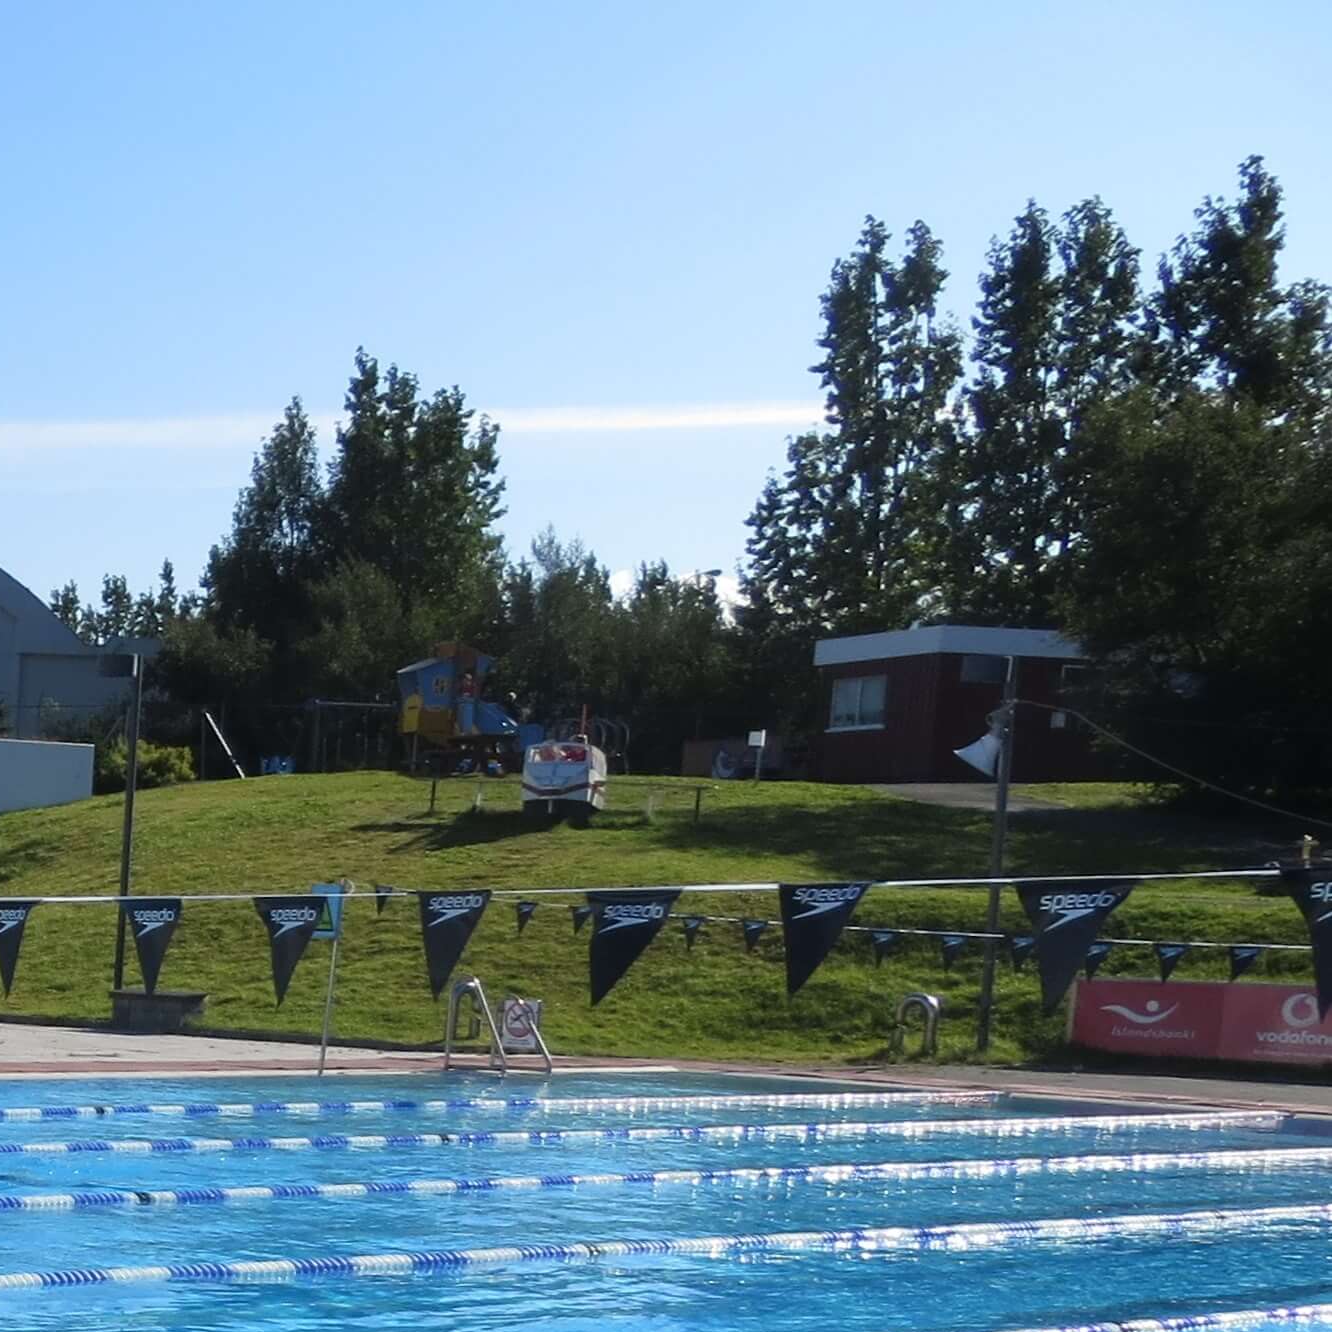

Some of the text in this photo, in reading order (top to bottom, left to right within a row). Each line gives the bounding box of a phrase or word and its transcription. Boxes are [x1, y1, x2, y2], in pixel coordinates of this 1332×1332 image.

[428, 893, 482, 911] speedo
[792, 884, 861, 904] speedo
[1039, 890, 1116, 914] speedo
[133, 908, 175, 922] speedo
[270, 907, 317, 922] speedo
[602, 902, 664, 920] speedo
